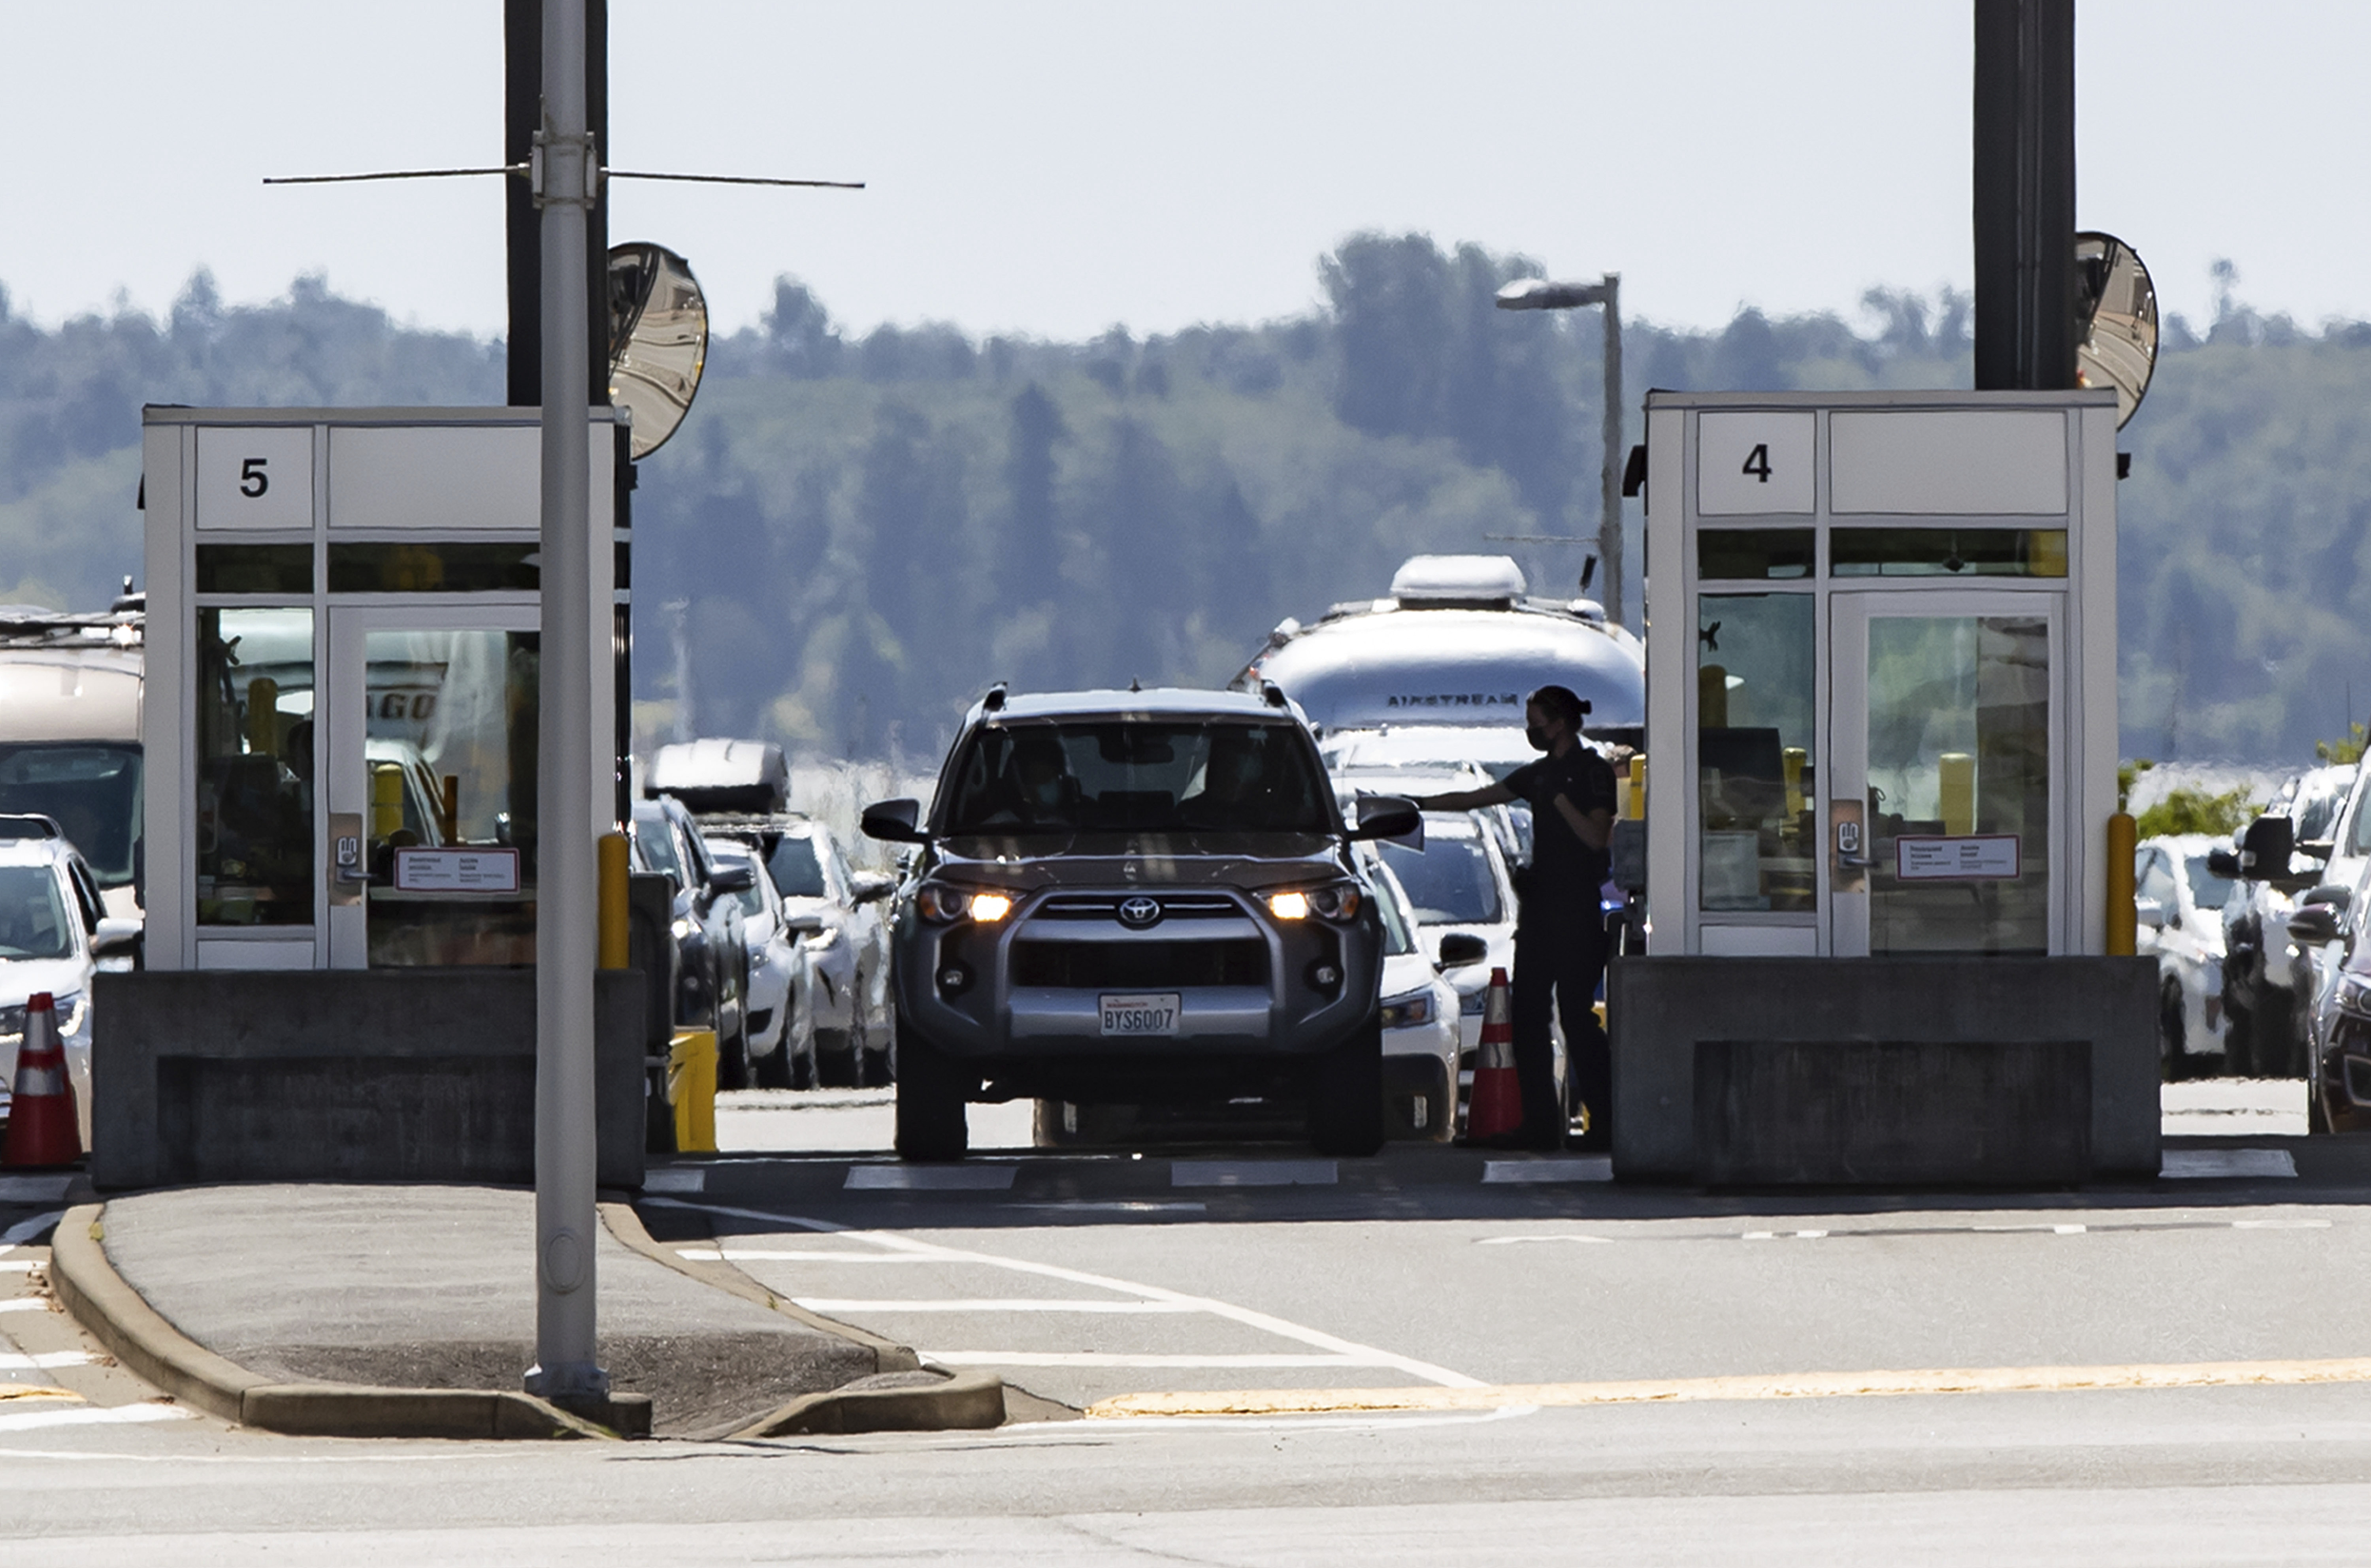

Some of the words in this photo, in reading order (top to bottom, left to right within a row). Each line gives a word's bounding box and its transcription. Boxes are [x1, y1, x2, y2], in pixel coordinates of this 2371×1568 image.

[240, 458, 268, 497] 5
[1742, 443, 1772, 483] 4
[1105, 1009, 1174, 1029] BYS6007
